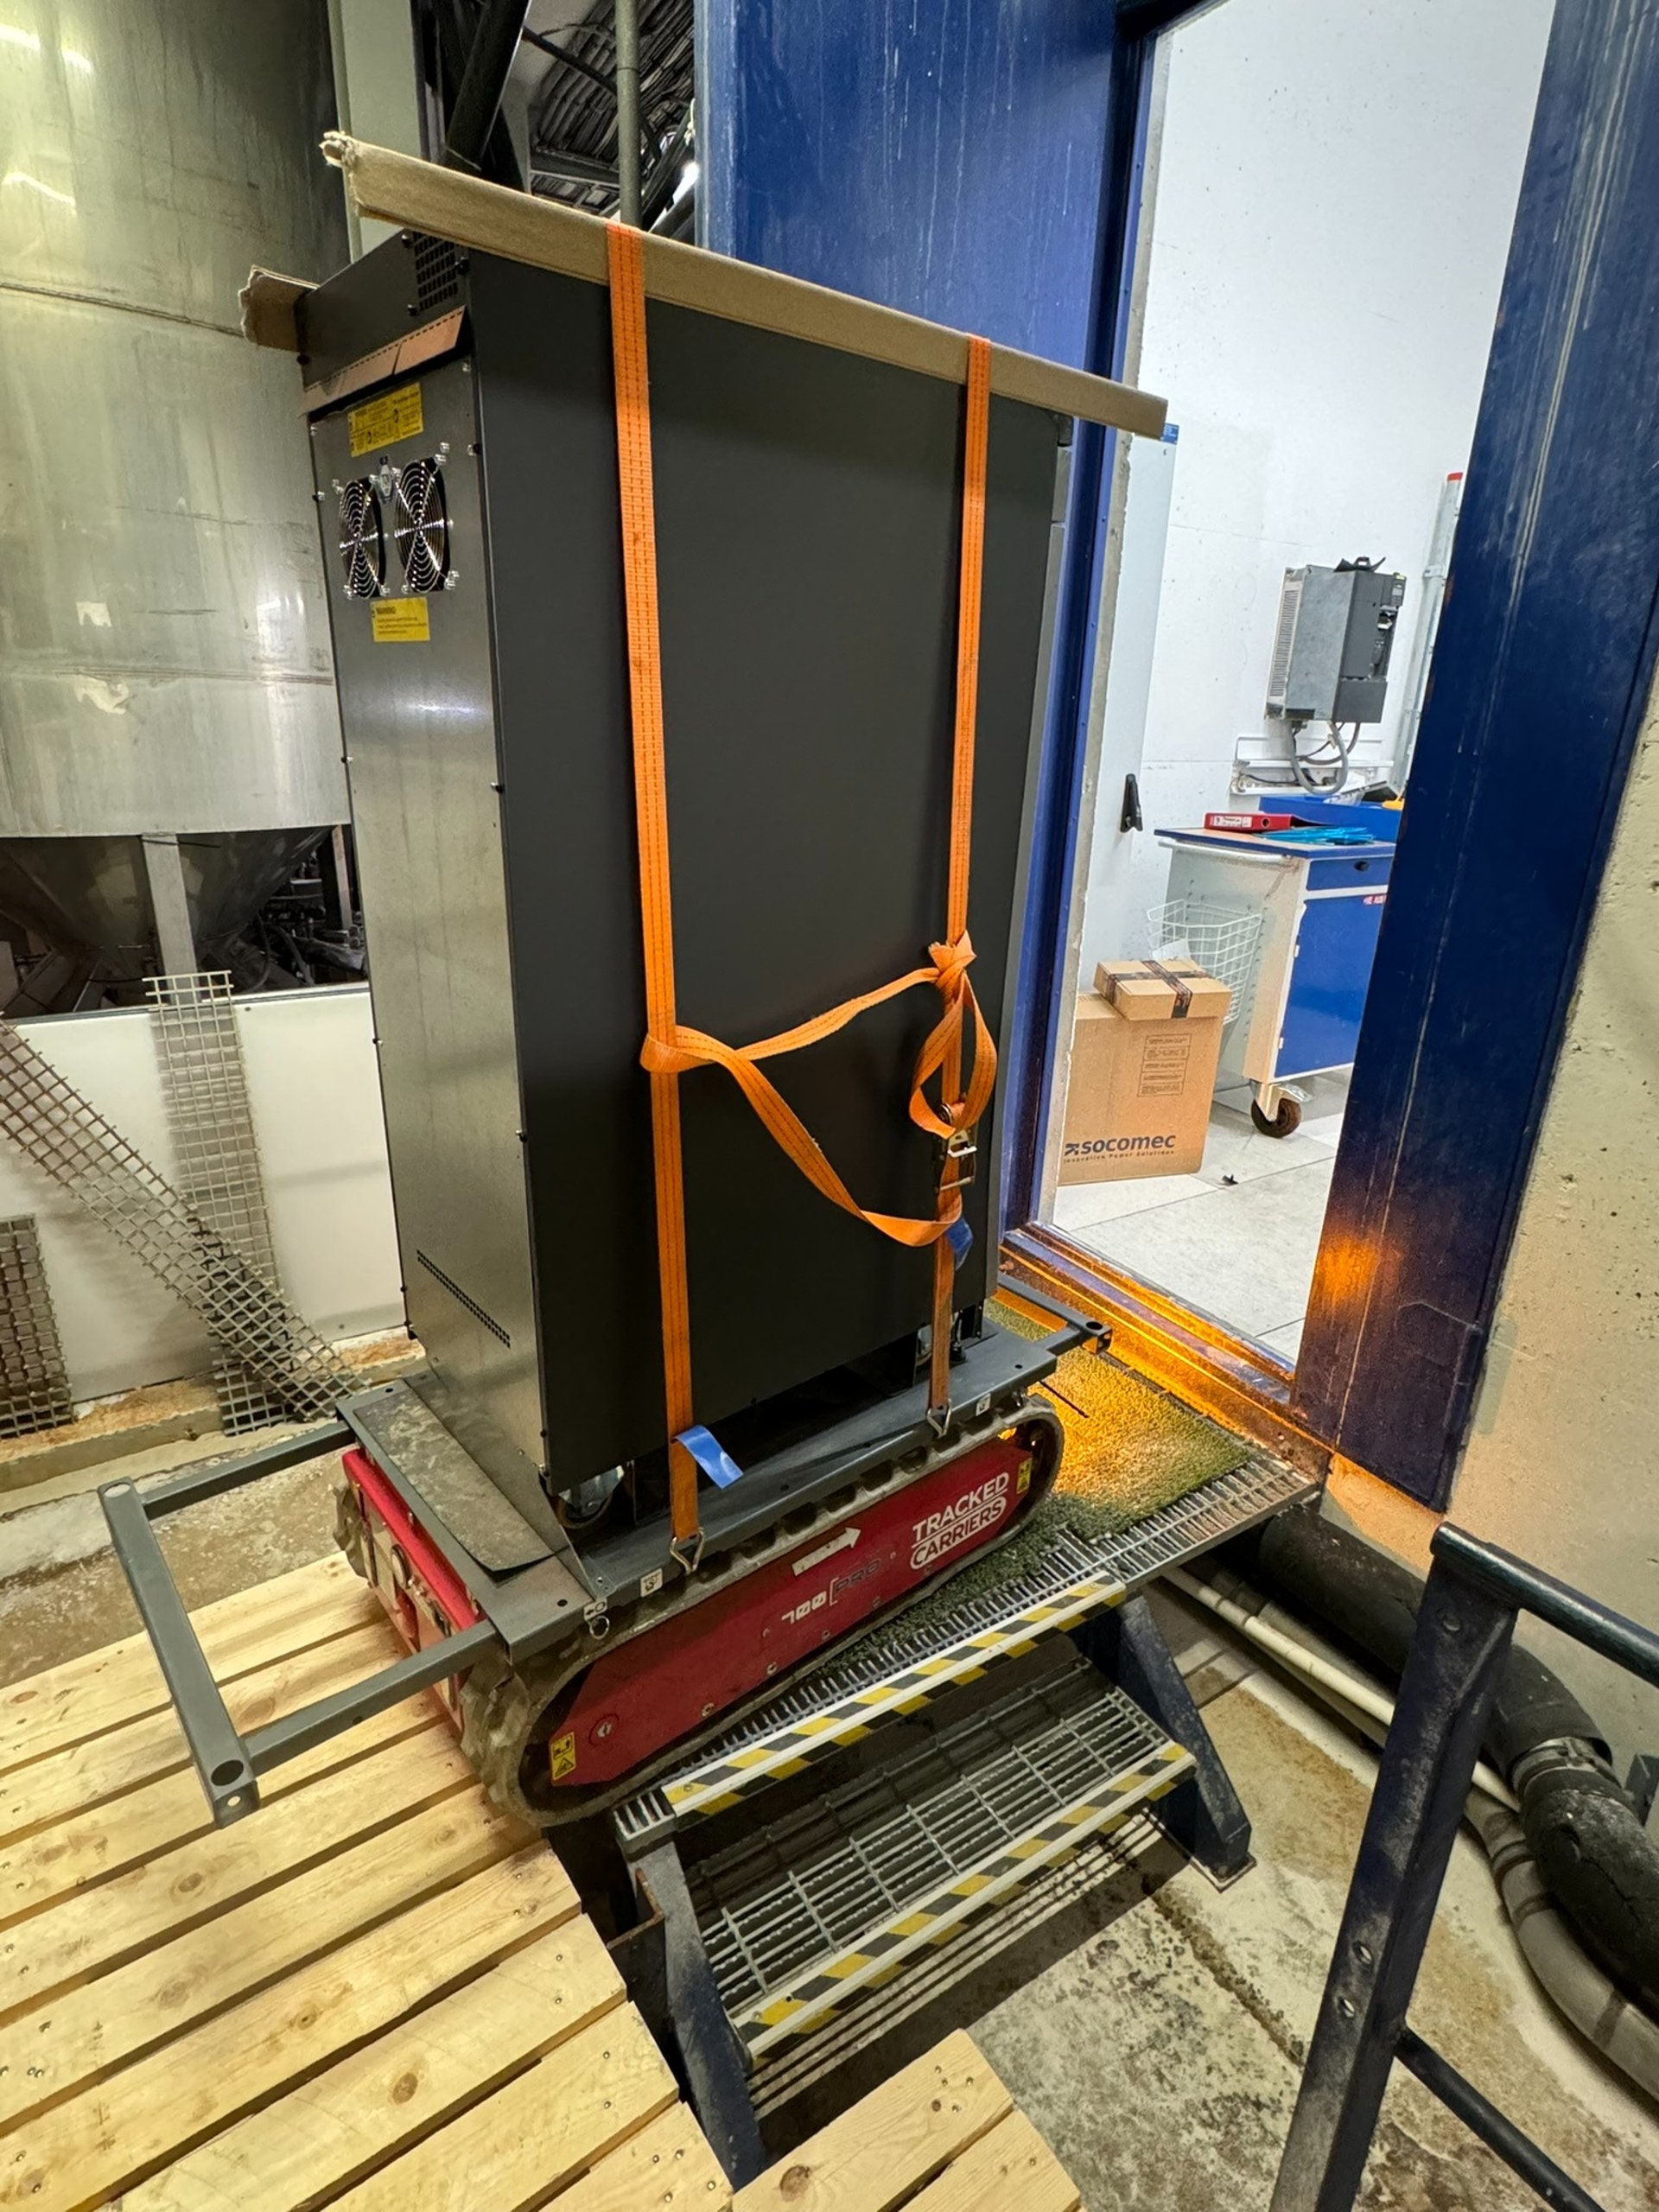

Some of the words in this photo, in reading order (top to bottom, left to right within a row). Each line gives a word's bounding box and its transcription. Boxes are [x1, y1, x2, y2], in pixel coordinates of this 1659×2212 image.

[1080, 1135, 1176, 1154] socomec
[912, 1471, 1009, 1541] TRACKED
[913, 1498, 1003, 1566] CARRIERS
[781, 1591, 827, 1624] 700
